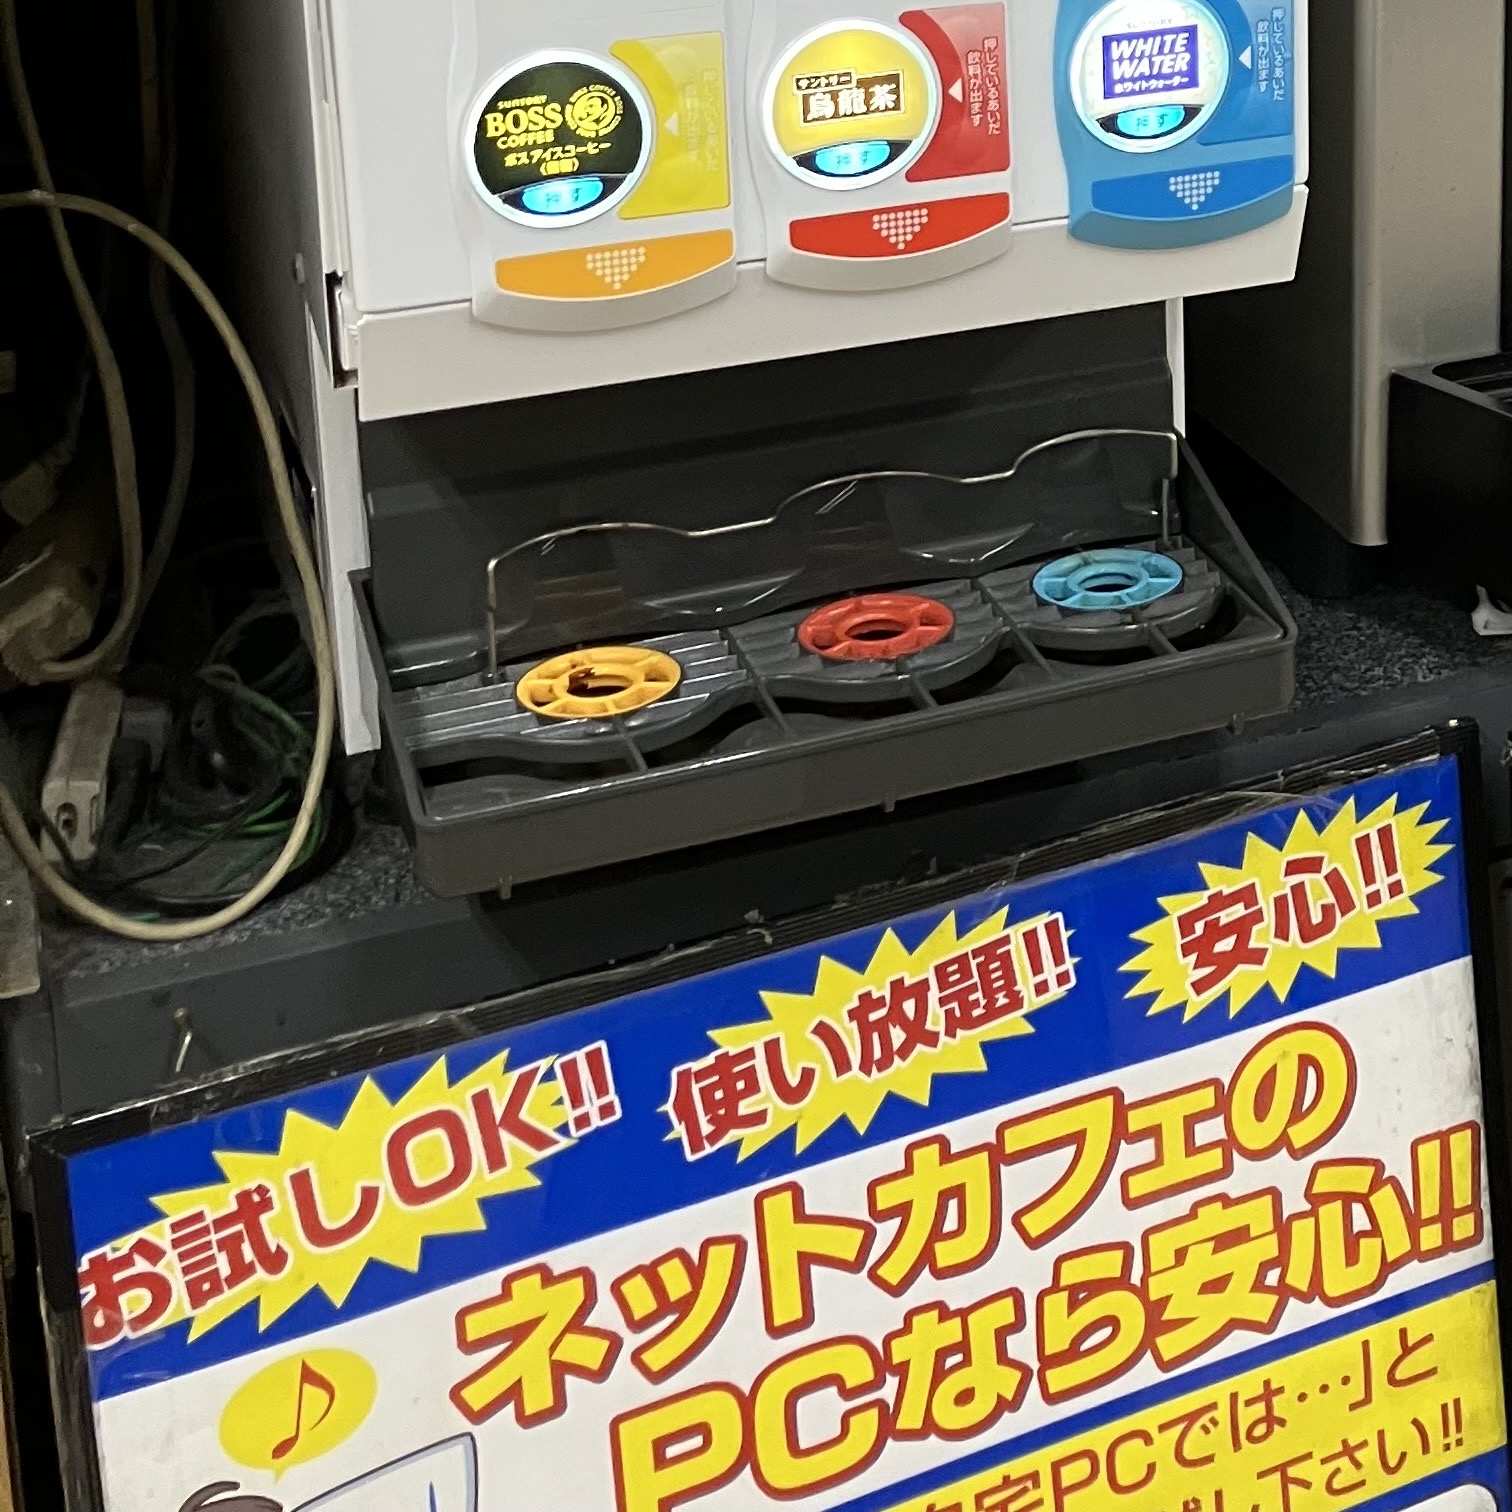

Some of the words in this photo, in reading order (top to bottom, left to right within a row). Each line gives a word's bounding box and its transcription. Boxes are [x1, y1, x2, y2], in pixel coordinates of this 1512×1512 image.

[798, 72, 852, 90] サントリー
[966, 49, 981, 127] 飲料が出ます
[983, 37, 1001, 136] 押しているあいだ
[1111, 32, 1190, 61] WHITE
[1112, 52, 1191, 80] WATER
[484, 102, 564, 138] BOSS
[496, 128, 555, 150] COFFEE
[1176, 823, 1406, 997] 安心!!
[670, 914, 1076, 1160] 使い放題!!
[80, 1042, 620, 1344] お試しOK!!
[450, 1020, 1358, 1428] ネットカフェの
[608, 1120, 1484, 1512] PCなら安心!!
